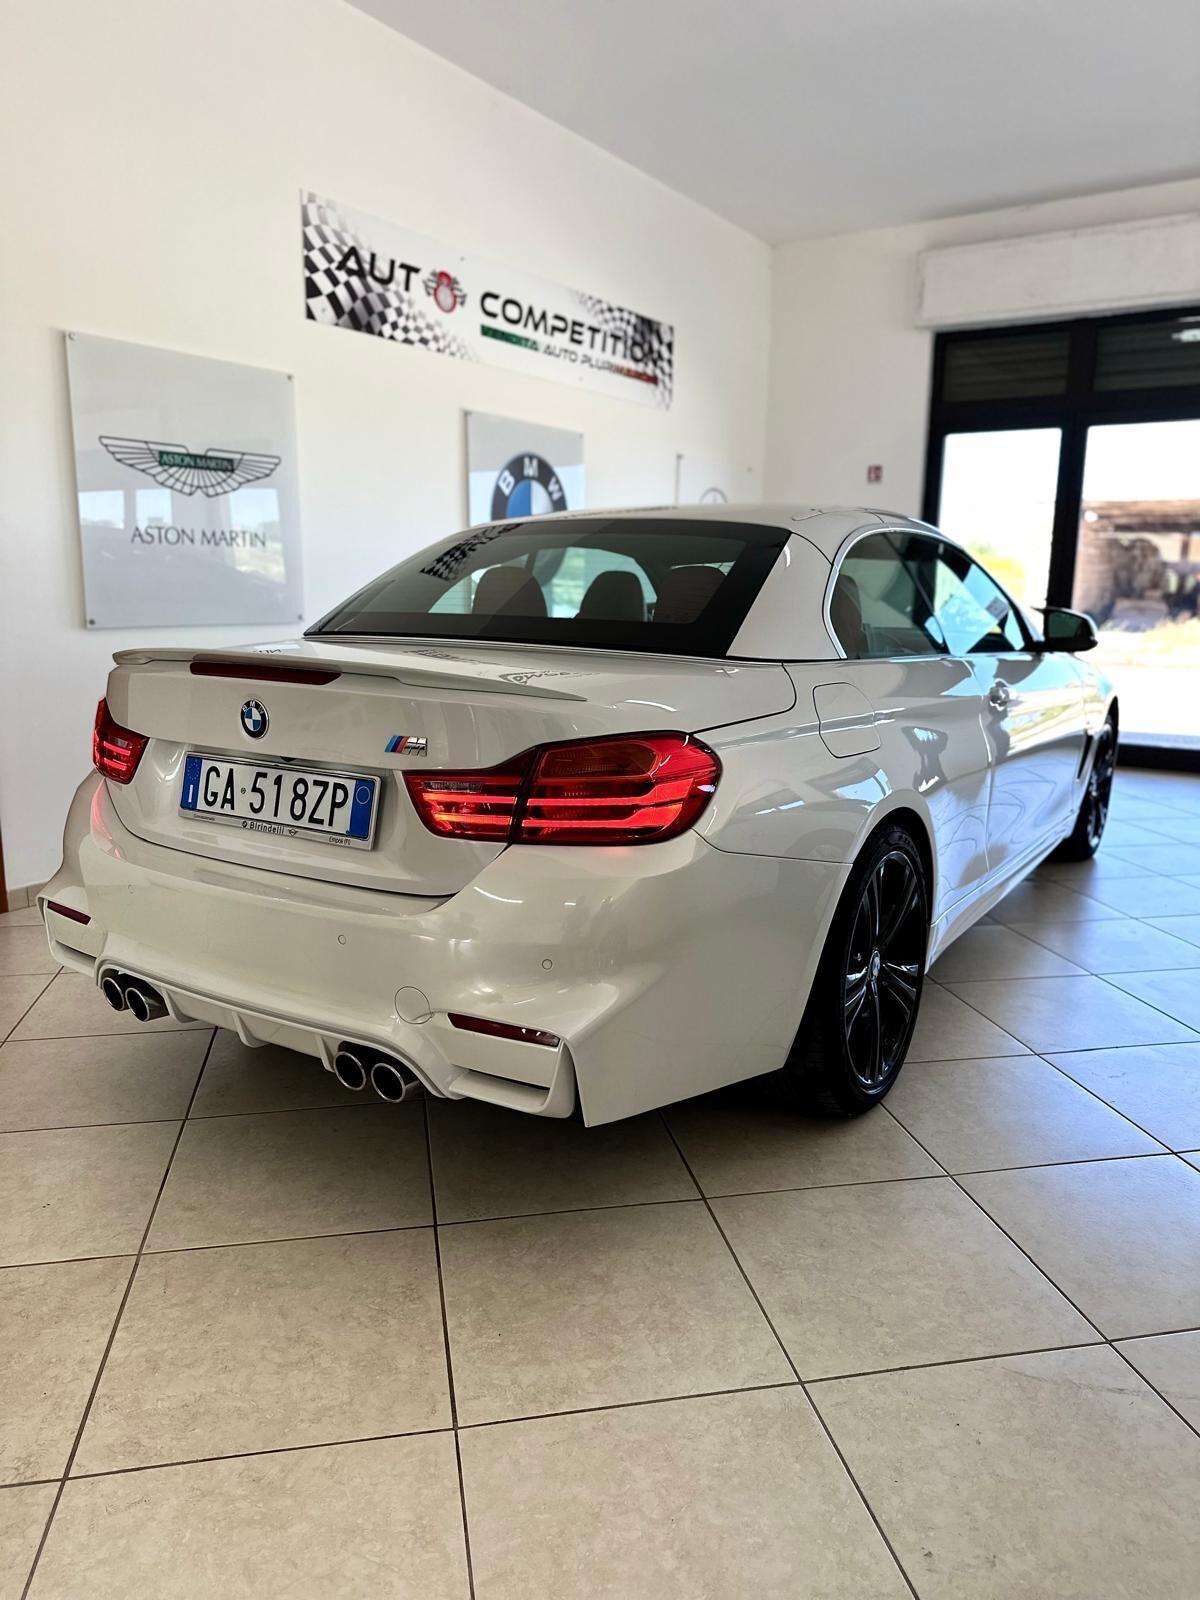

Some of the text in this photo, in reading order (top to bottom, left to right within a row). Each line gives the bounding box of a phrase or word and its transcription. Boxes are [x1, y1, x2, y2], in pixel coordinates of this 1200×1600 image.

[543, 344, 578, 362] AUTO
[161, 453, 195, 466] ASTON
[498, 456, 562, 500] BMW
[131, 526, 266, 548] ASTON MARTIN
[242, 700, 265, 714] BMW
[250, 821, 285, 836] Birindelli
